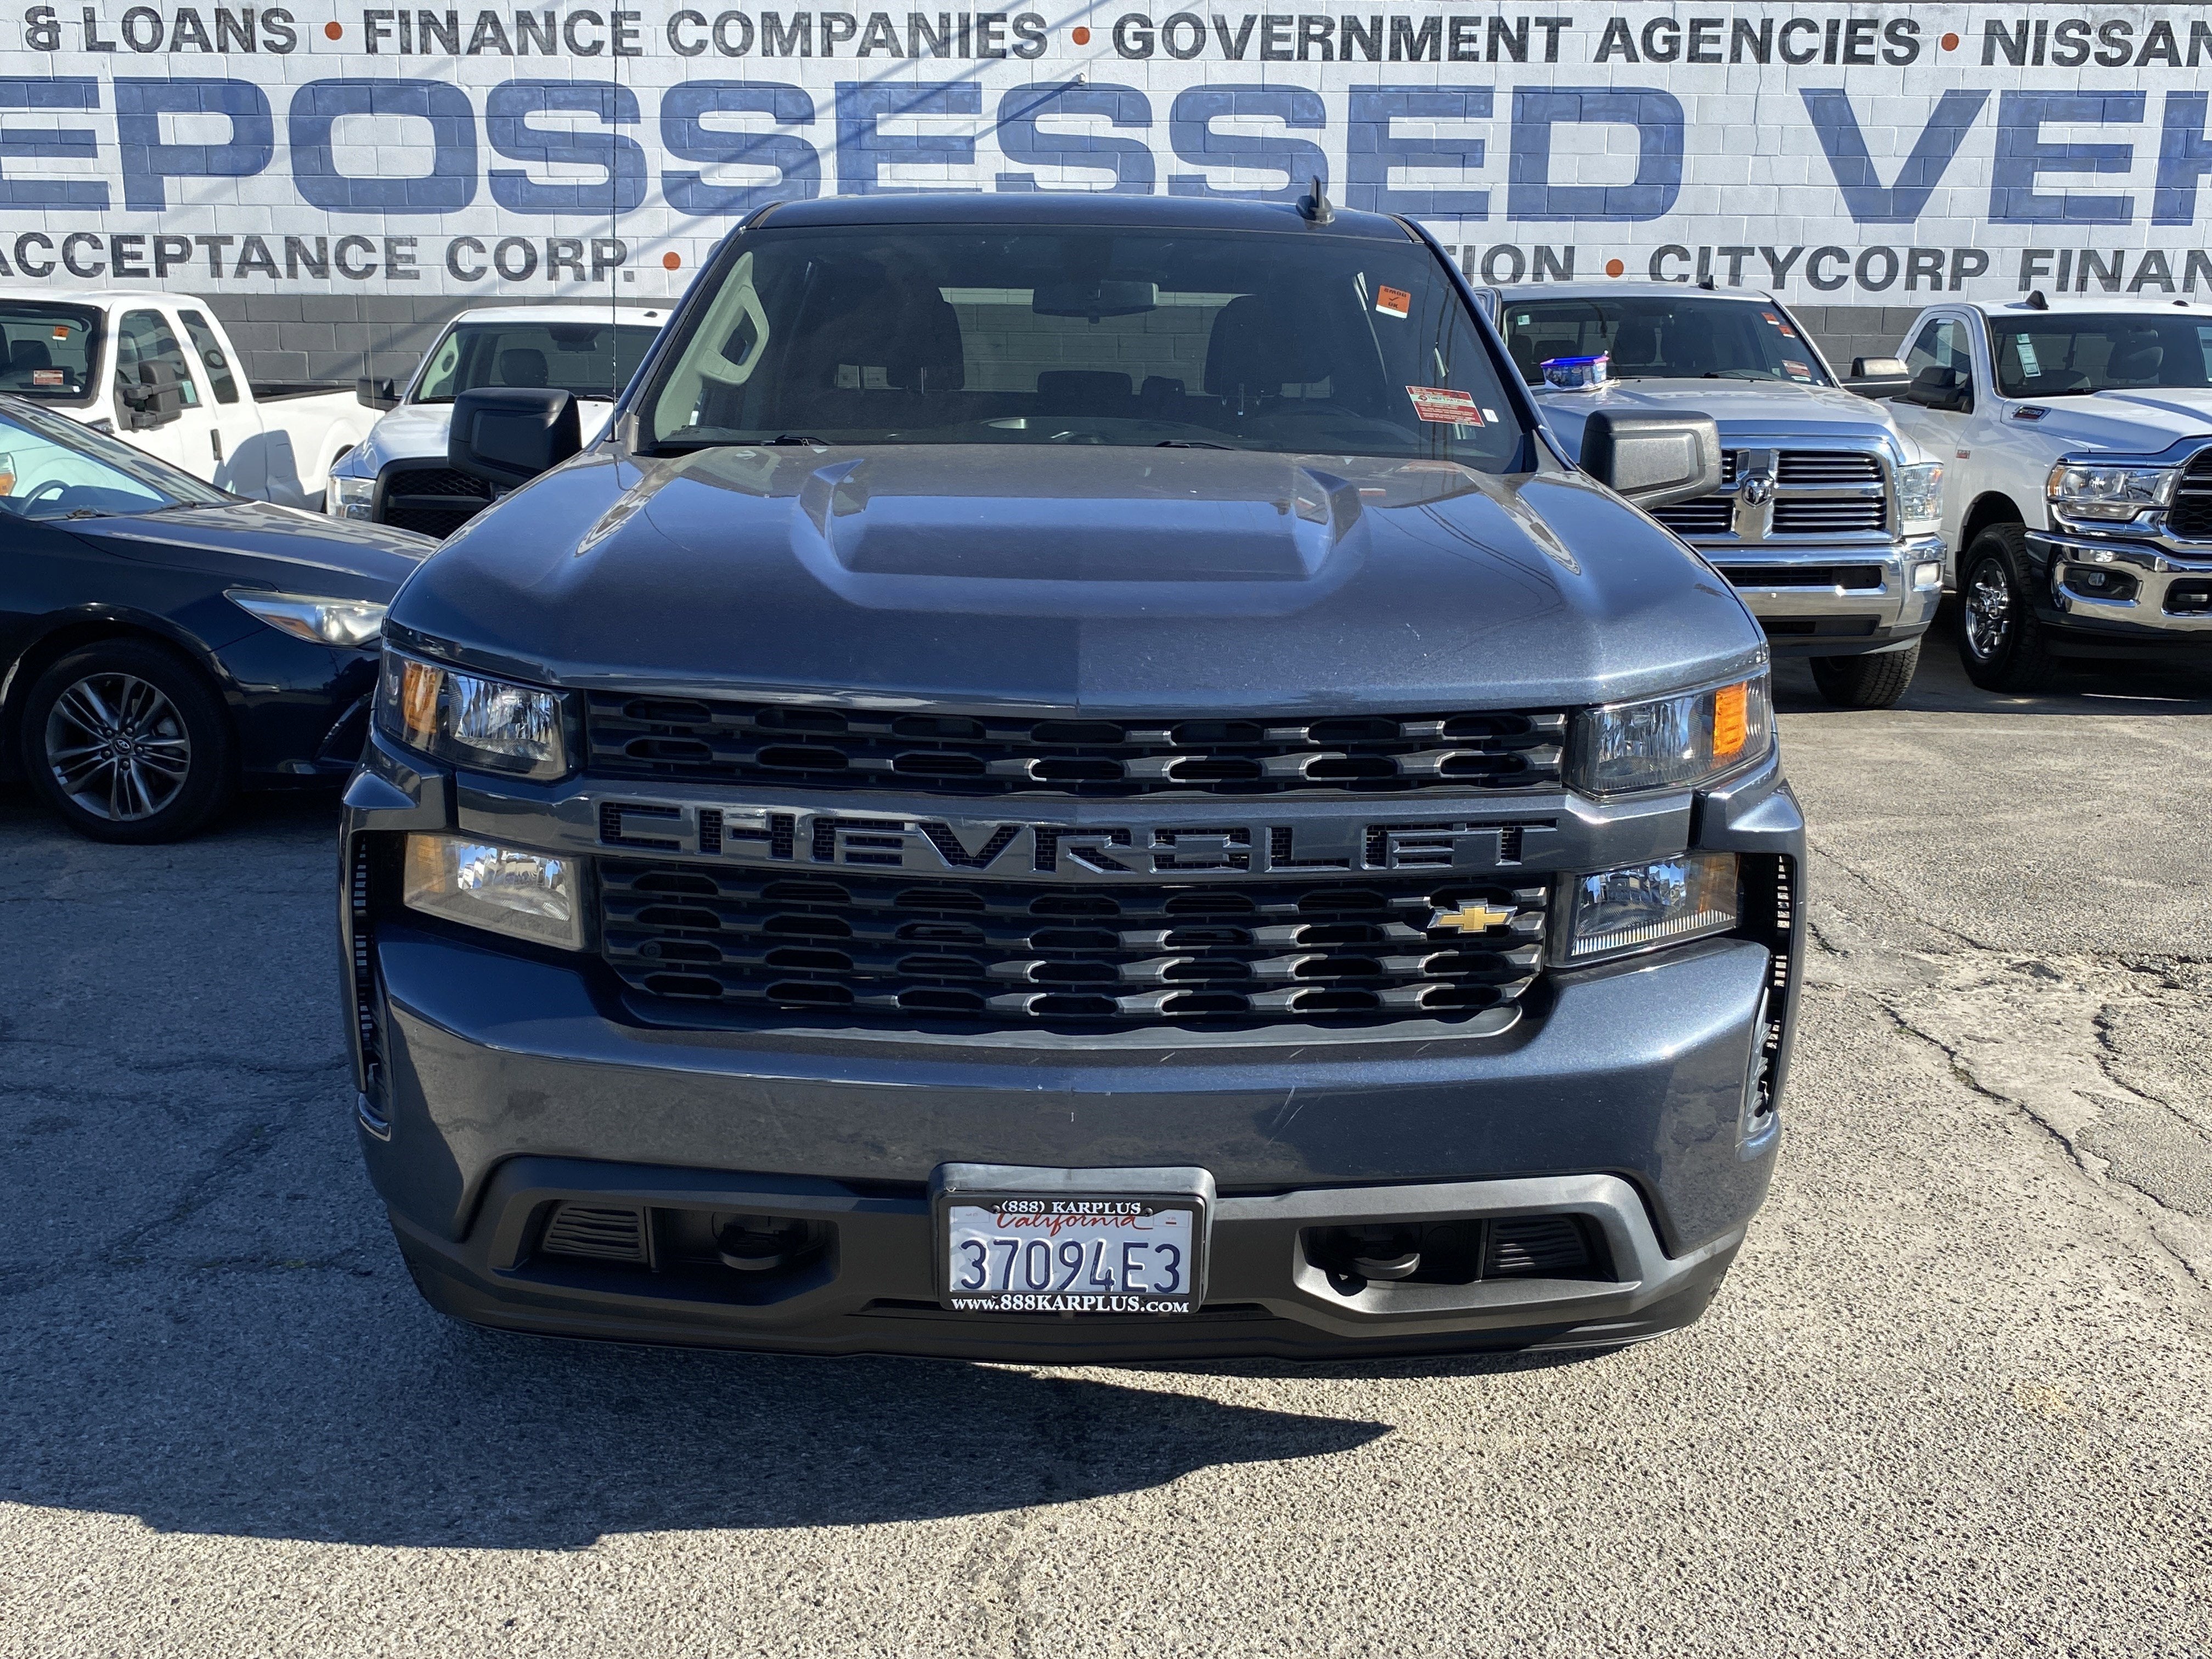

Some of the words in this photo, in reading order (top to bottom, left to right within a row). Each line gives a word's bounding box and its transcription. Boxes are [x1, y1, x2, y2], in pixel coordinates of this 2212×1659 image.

[25, 7, 61, 51] &
[84, 7, 297, 54] LOANS
[364, 9, 642, 57] FINANCE
[666, 10, 1048, 59] COMPANIES
[1112, 13, 1573, 63] GOVERNMENT
[1593, 17, 1921, 65] AGENCIES
[1980, 19, 2212, 67] NISSAN
[0, 76, 1684, 222] EPOSSESSED
[446, 236, 635, 283] CORP.
[1443, 244, 1575, 286] ION
[1649, 244, 1990, 292] CITYCORP
[2018, 250, 2212, 293] FINAN
[599, 801, 1559, 873] CHEVROLET
[997, 1212, 1154, 1237] California
[1001, 1200, 1045, 1213] (888)
[1052, 1201, 1141, 1215] KARPLUS
[960, 1239, 1181, 1293] 37094E3
